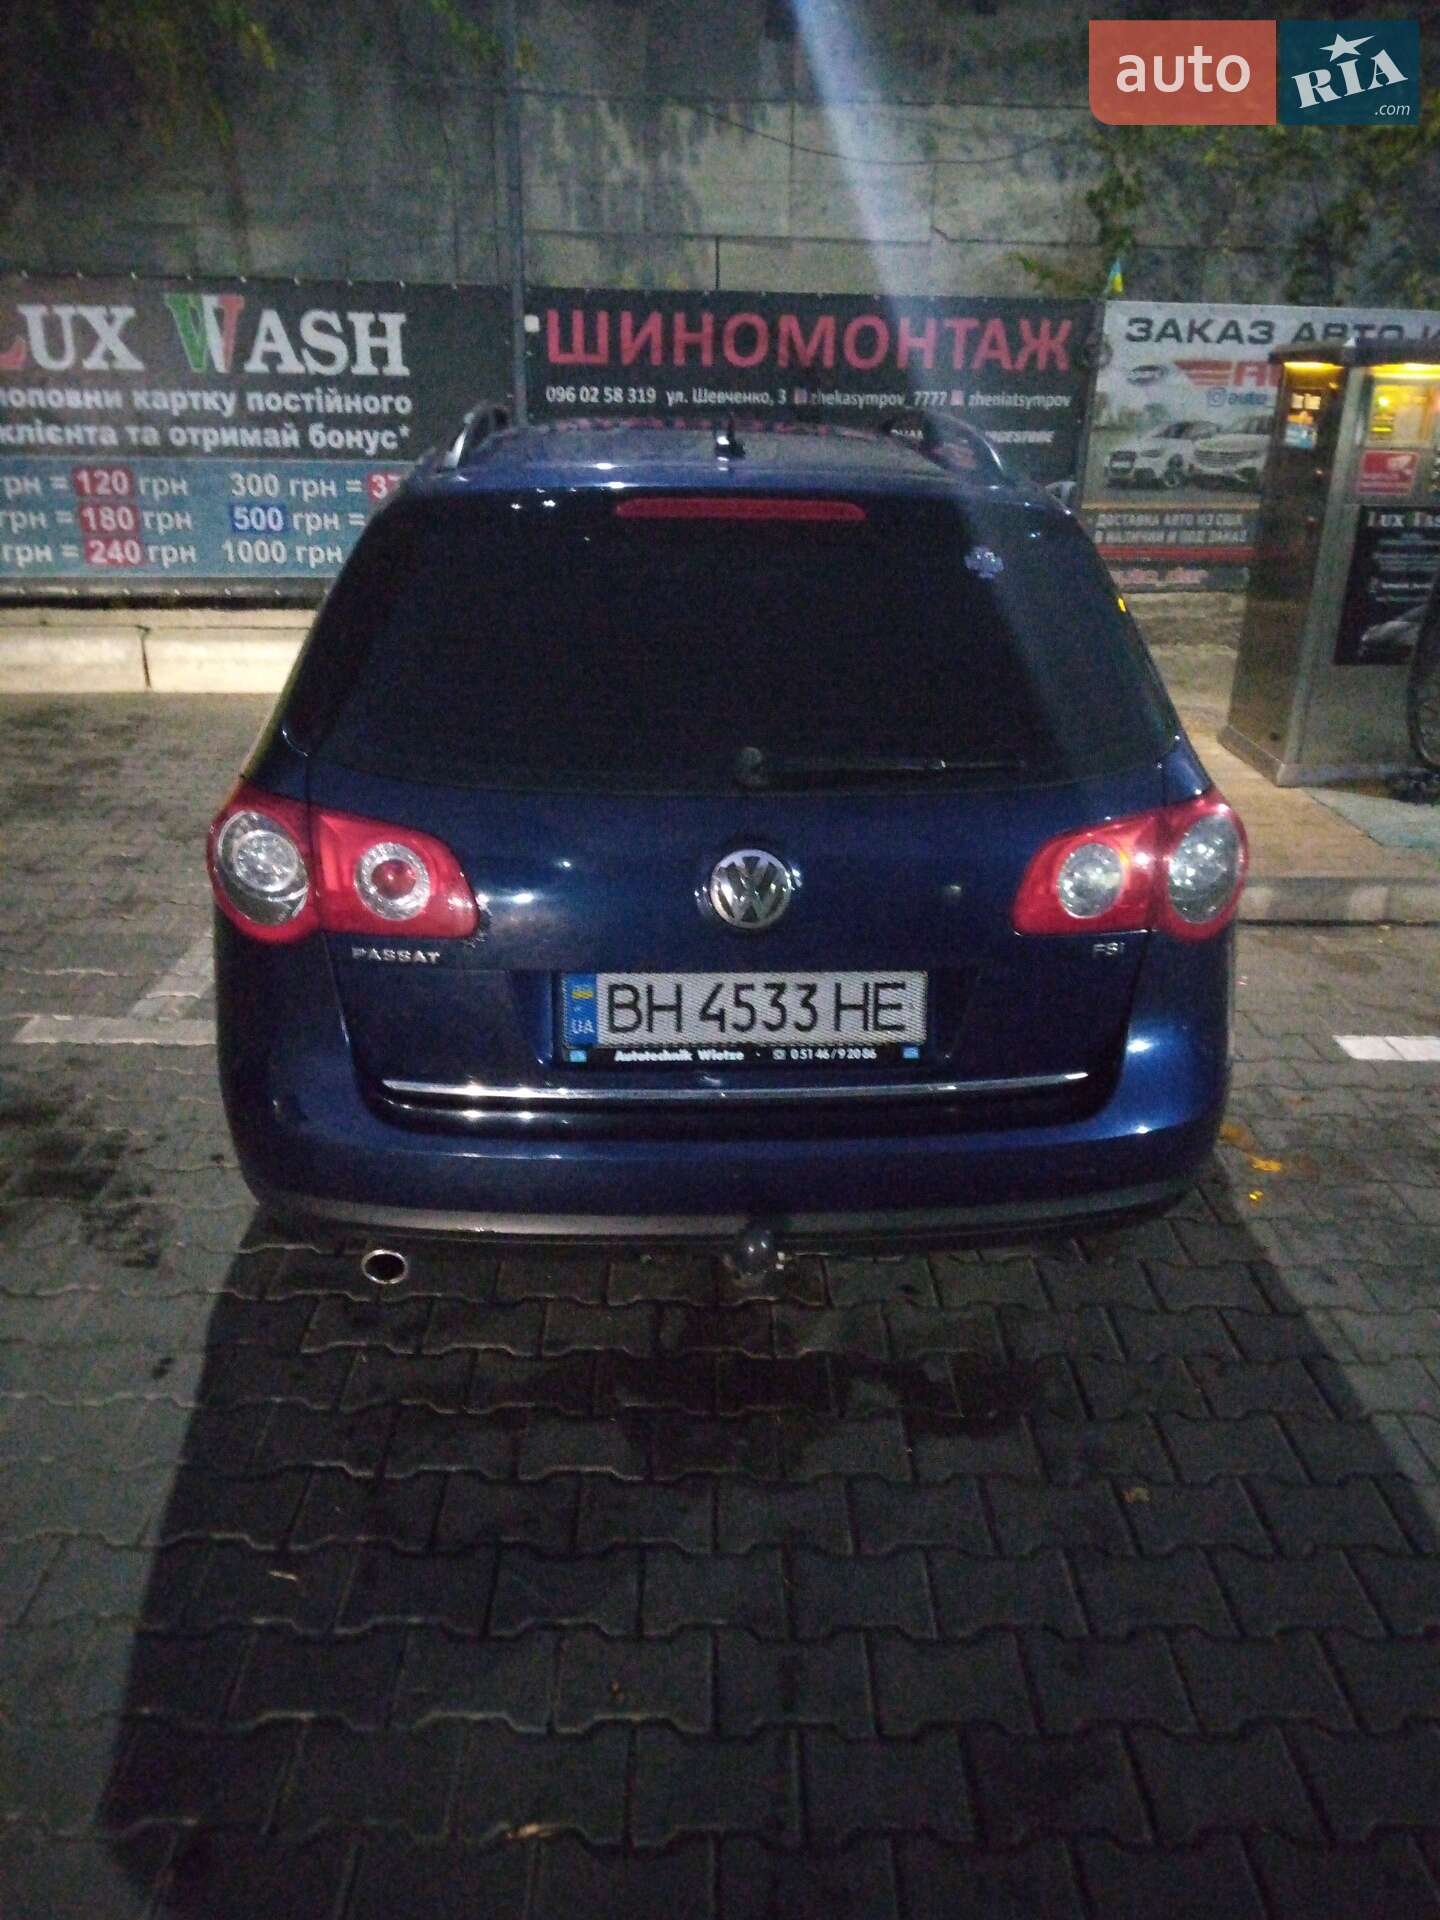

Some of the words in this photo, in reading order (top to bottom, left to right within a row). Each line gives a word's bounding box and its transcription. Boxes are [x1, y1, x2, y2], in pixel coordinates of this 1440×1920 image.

[164, 294, 411, 376] WASH
[545, 308, 1073, 373] ШИНОМОНТАЖ
[1126, 317, 1275, 344] ЗАКАЗ
[133, 391, 237, 418] картку
[246, 387, 413, 415] постійного
[545, 385, 576, 403] 096
[579, 386, 599, 403] 02
[603, 386, 624, 403] 58
[627, 386, 657, 404] 319
[778, 388, 787, 405] 3
[126, 427, 160, 446] та
[169, 423, 300, 452] отримай
[76, 470, 130, 495] 120
[139, 477, 189, 501] грн
[230, 472, 280, 497] 300
[289, 478, 338, 502] грн
[82, 506, 135, 532] 180
[144, 511, 193, 536] грн
[233, 506, 284, 531] 500
[292, 511, 341, 537] грн
[2, 543, 53, 569] грн
[89, 538, 142, 565] 240
[148, 544, 197, 569] грн
[222, 539, 287, 564] 1000
[295, 545, 343, 569] грн
[351, 946, 441, 965] PASSAT
[607, 983, 683, 1034] BH
[700, 982, 818, 1034] 4533
[834, 982, 906, 1032] HE
[571, 1019, 595, 1034] UA
